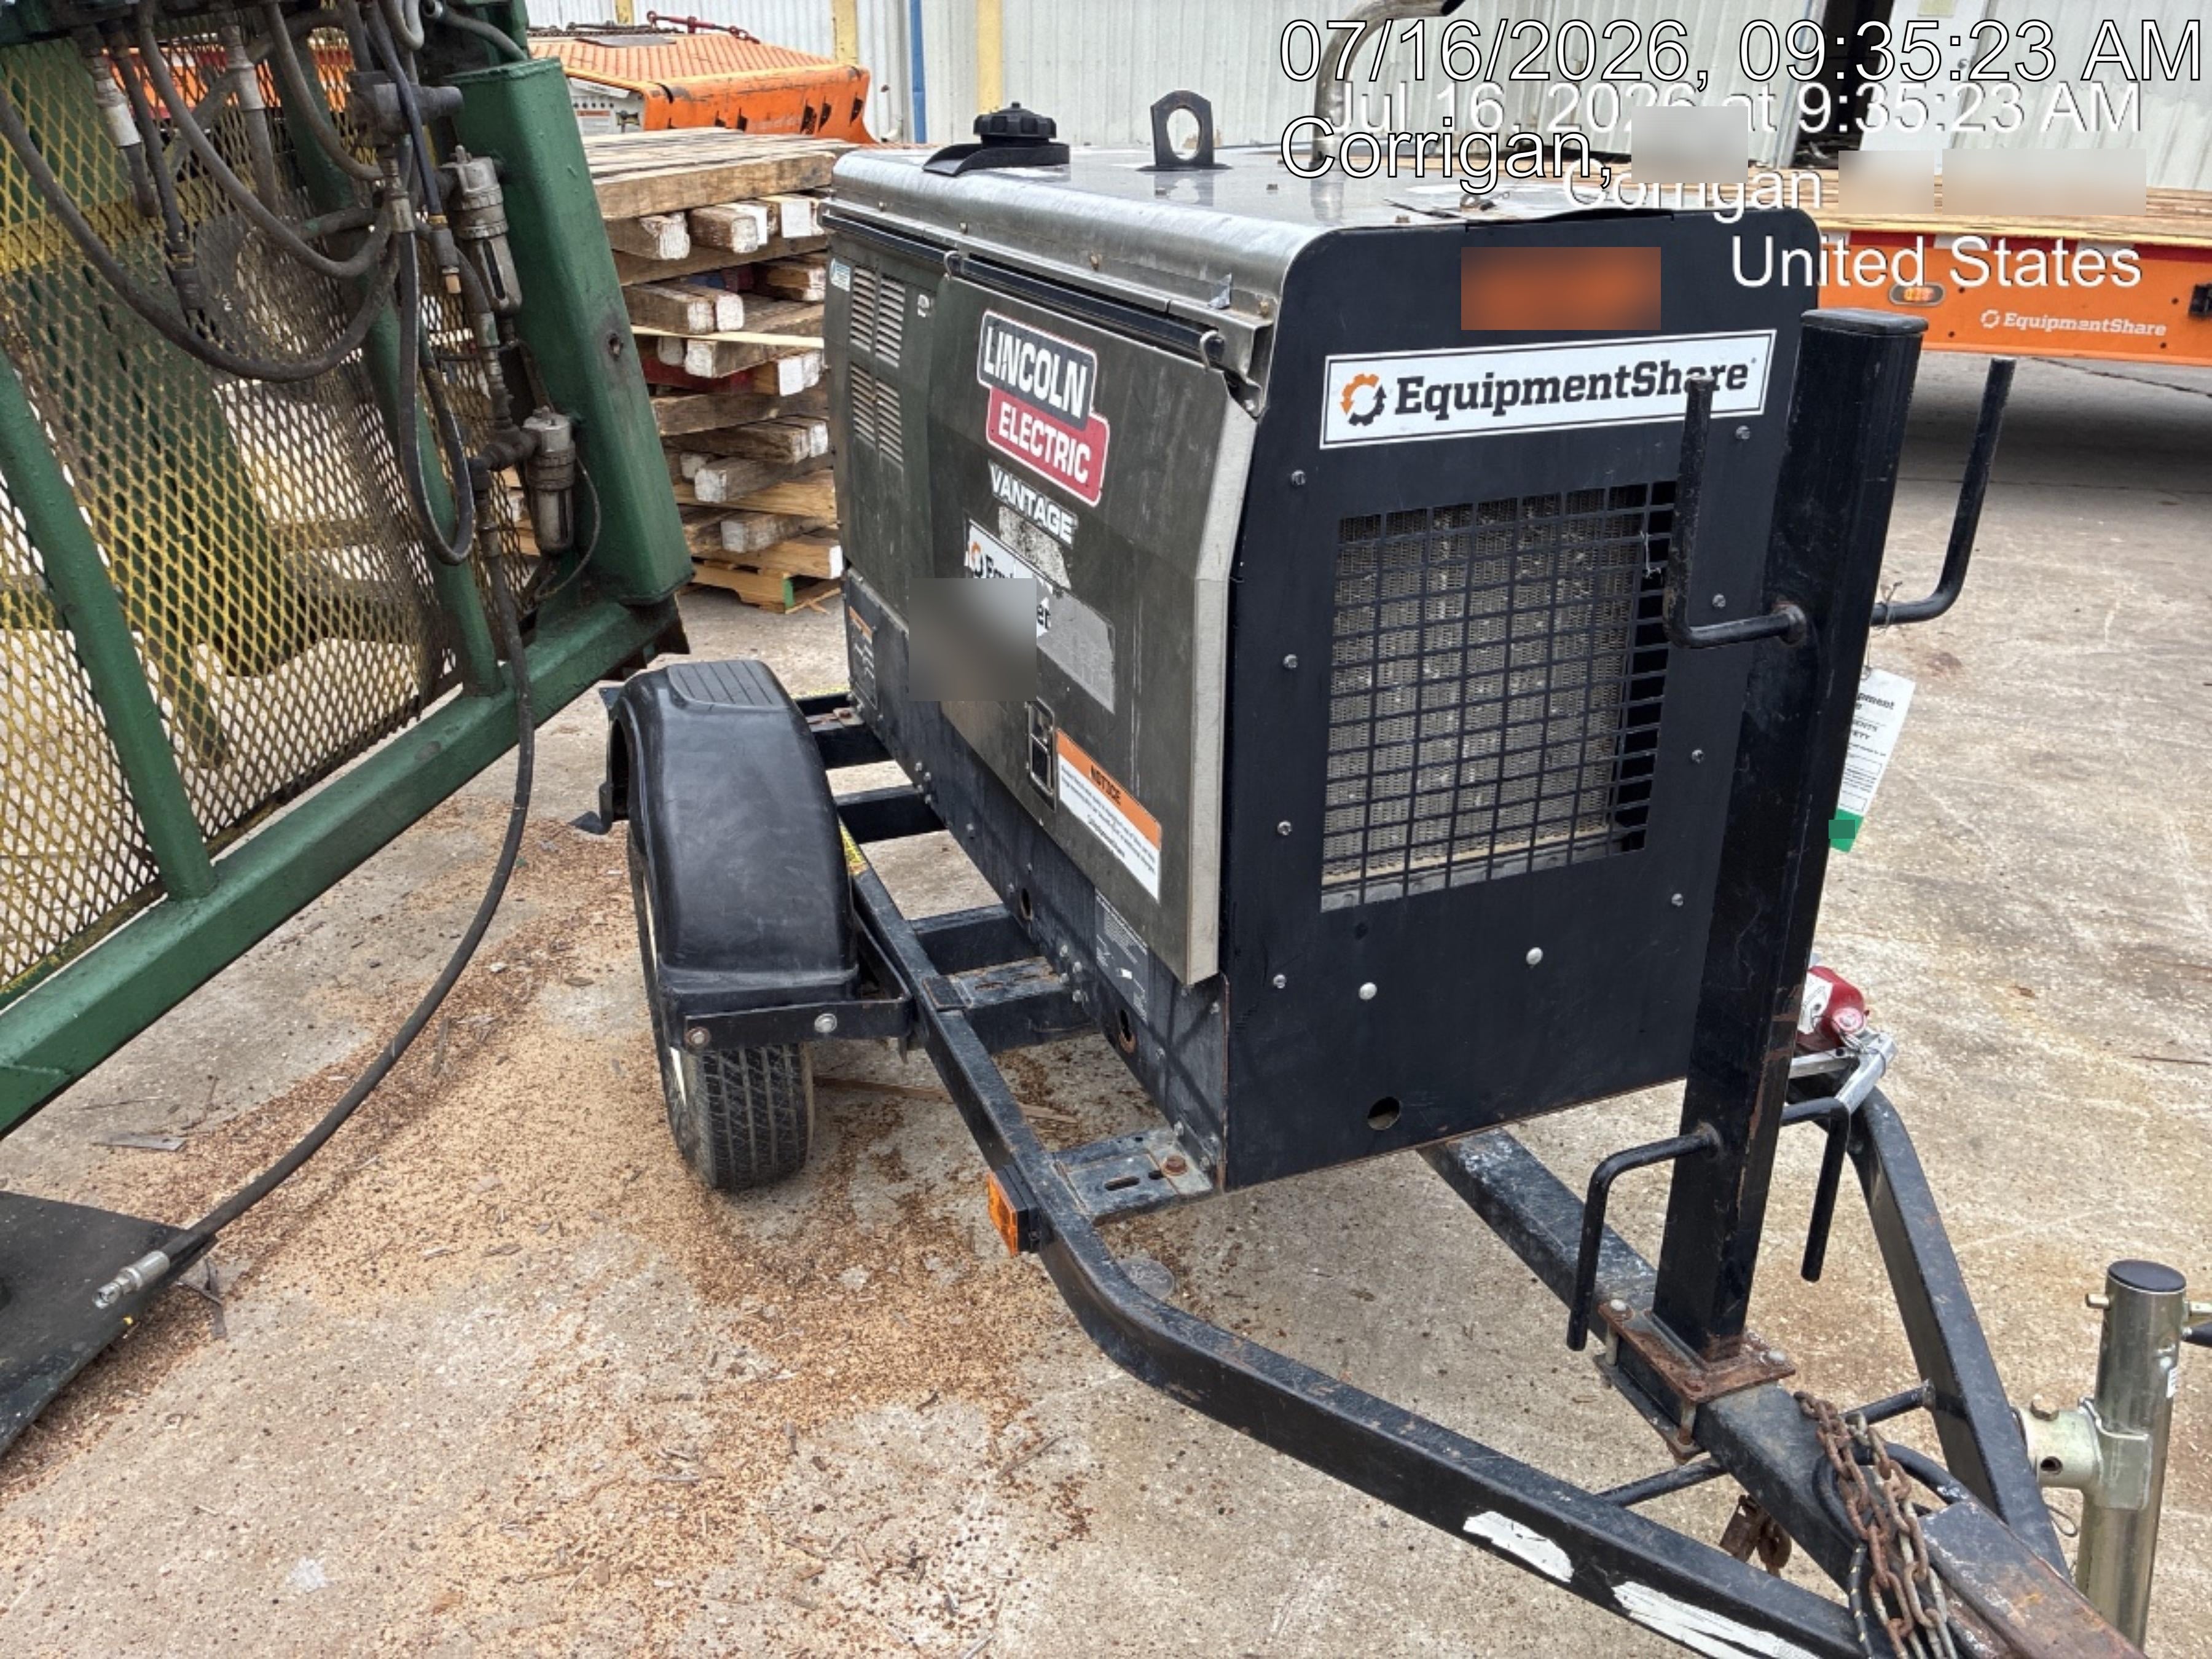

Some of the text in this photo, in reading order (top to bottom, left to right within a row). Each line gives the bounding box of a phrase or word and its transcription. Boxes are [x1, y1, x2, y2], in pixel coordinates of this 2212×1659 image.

[2003, 312, 2167, 336] EquipmentShare
[983, 326, 1088, 419] LINCOLN
[998, 401, 1091, 484] ELECTRIC
[990, 465, 1075, 544] VANTAGE
